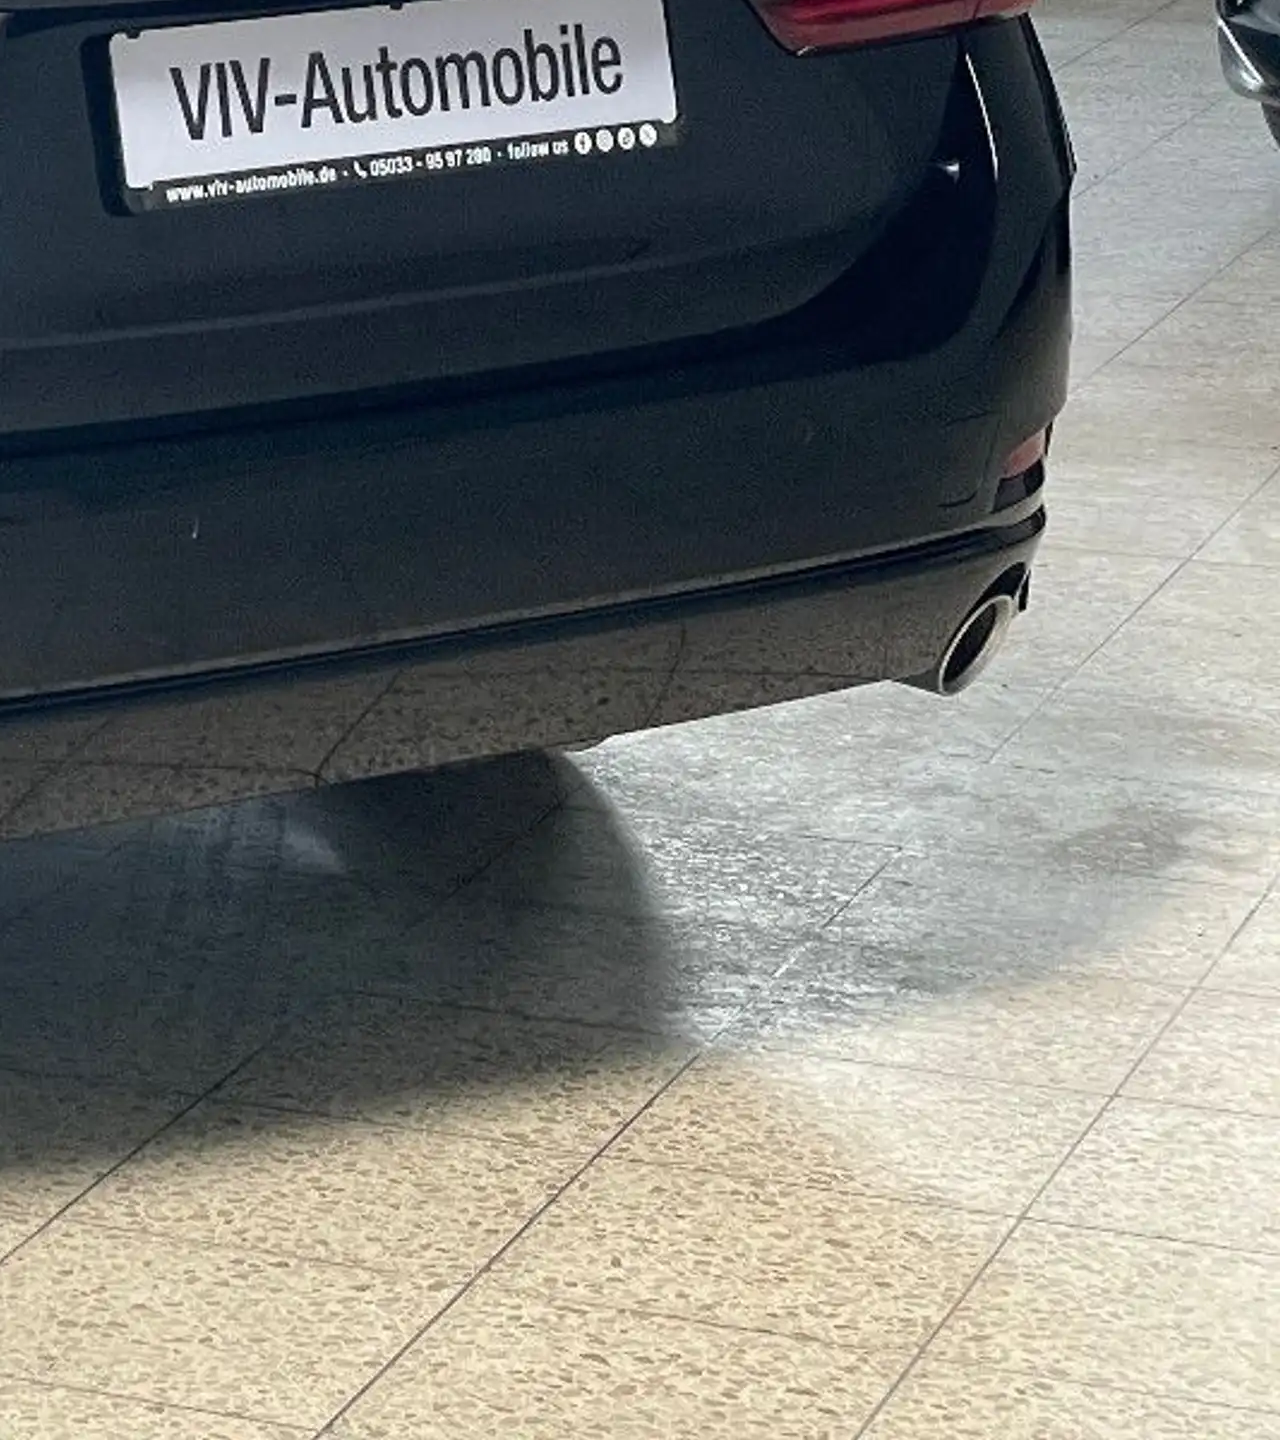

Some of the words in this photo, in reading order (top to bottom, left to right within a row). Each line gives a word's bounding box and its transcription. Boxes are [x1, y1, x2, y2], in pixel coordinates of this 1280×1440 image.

[169, 23, 624, 141] VIV-Automobile
[166, 165, 337, 203] www.viv-automobile.de
[370, 156, 414, 177] 05033
